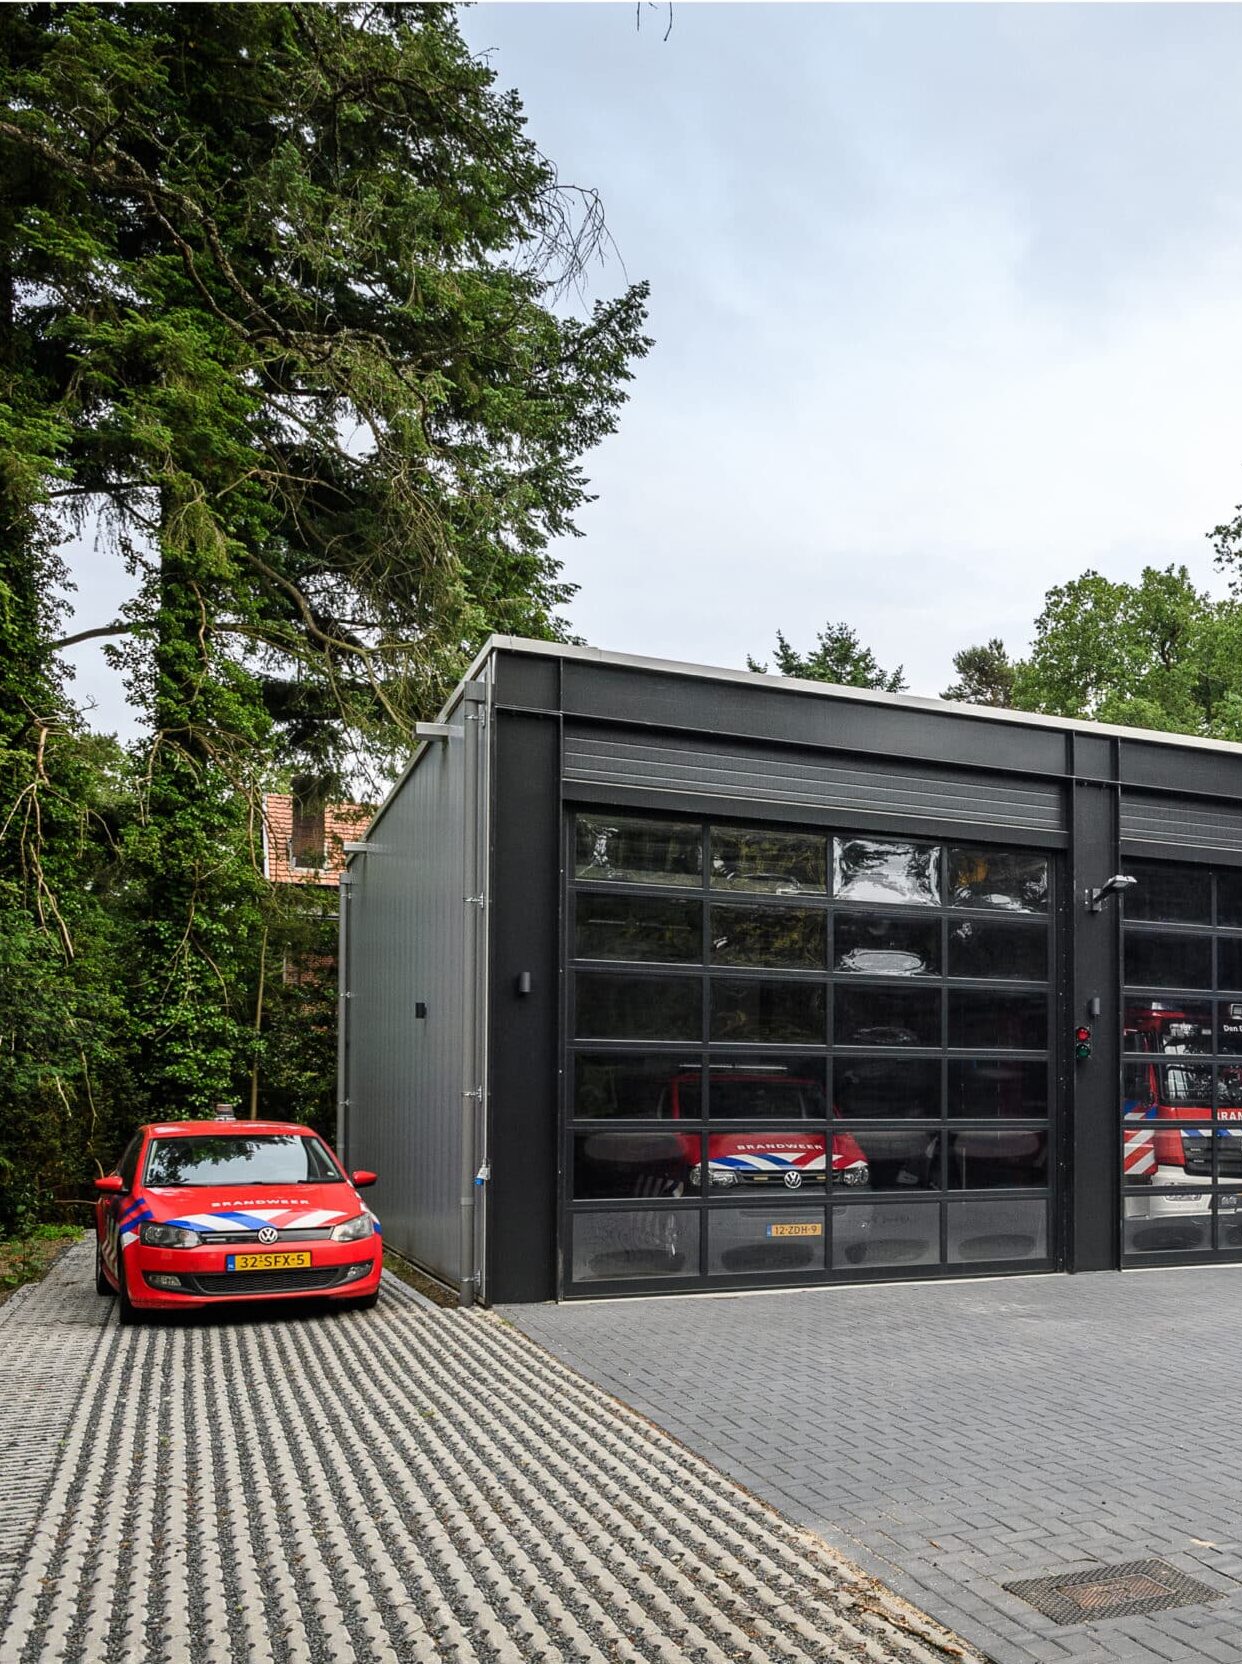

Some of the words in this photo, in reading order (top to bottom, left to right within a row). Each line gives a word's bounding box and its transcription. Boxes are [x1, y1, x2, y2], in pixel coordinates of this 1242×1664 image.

[1222, 1024, 1239, 1033] Den
[736, 1143, 824, 1151] BRANDWEER
[210, 1199, 311, 1207] BRANDWEER
[240, 1253, 306, 1269] 32-SFX-5
